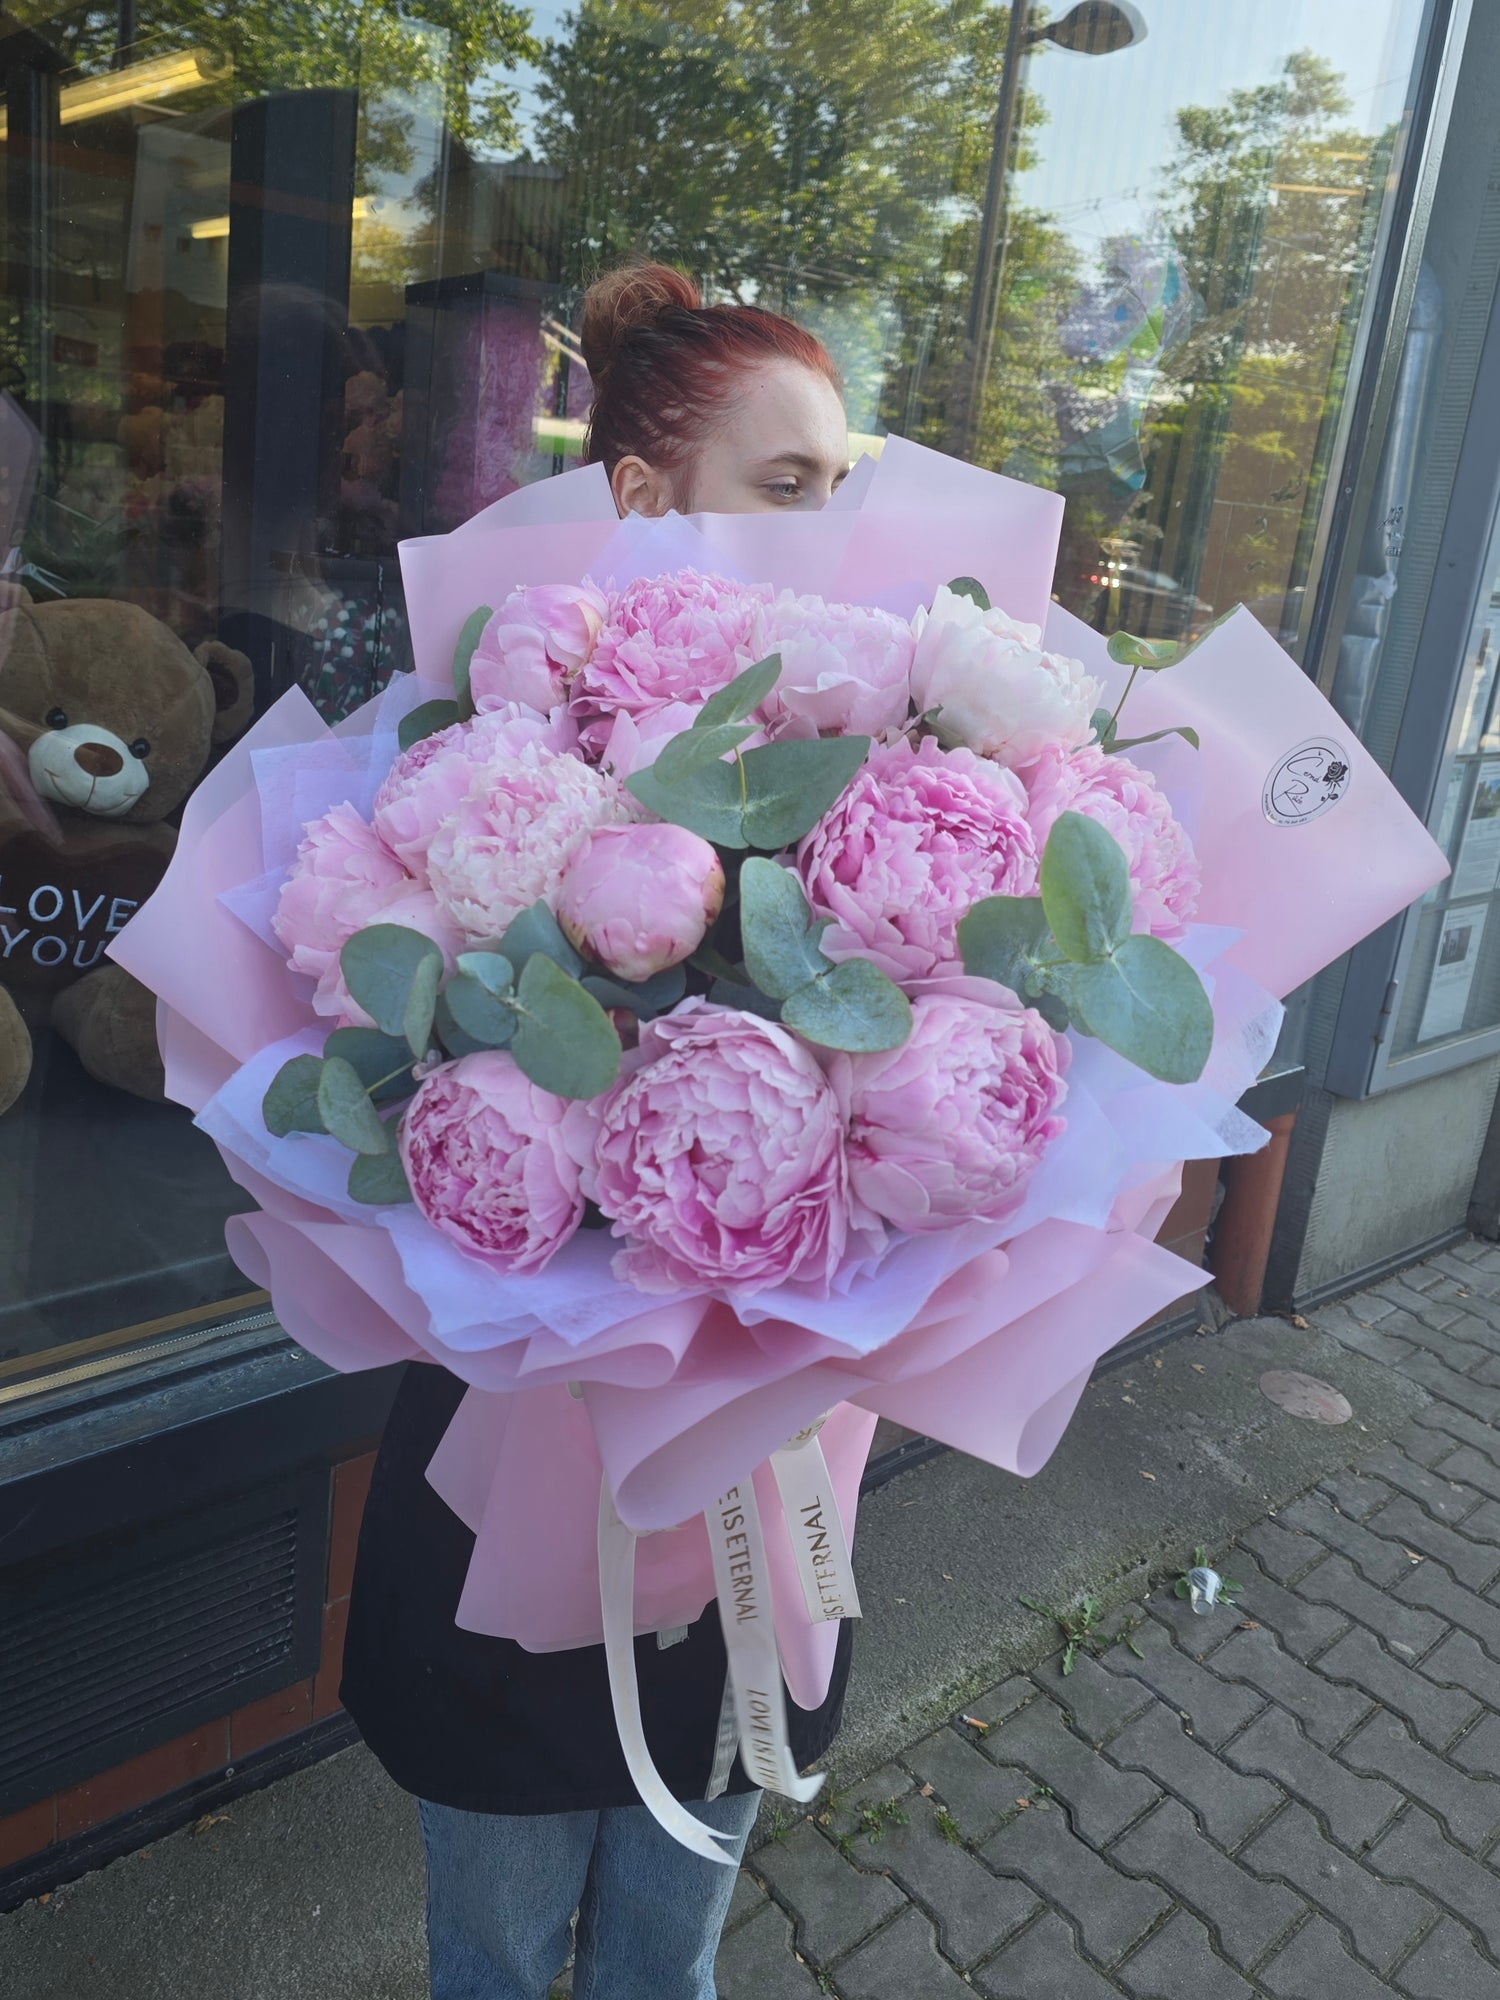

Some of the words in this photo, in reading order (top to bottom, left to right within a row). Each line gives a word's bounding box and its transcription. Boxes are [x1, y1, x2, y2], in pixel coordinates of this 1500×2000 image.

[0, 925, 106, 968] YOU
[721, 1505, 745, 1531] IS
[800, 1495, 842, 1604] ETERNAL
[726, 1532, 759, 1626] ETERNAL
